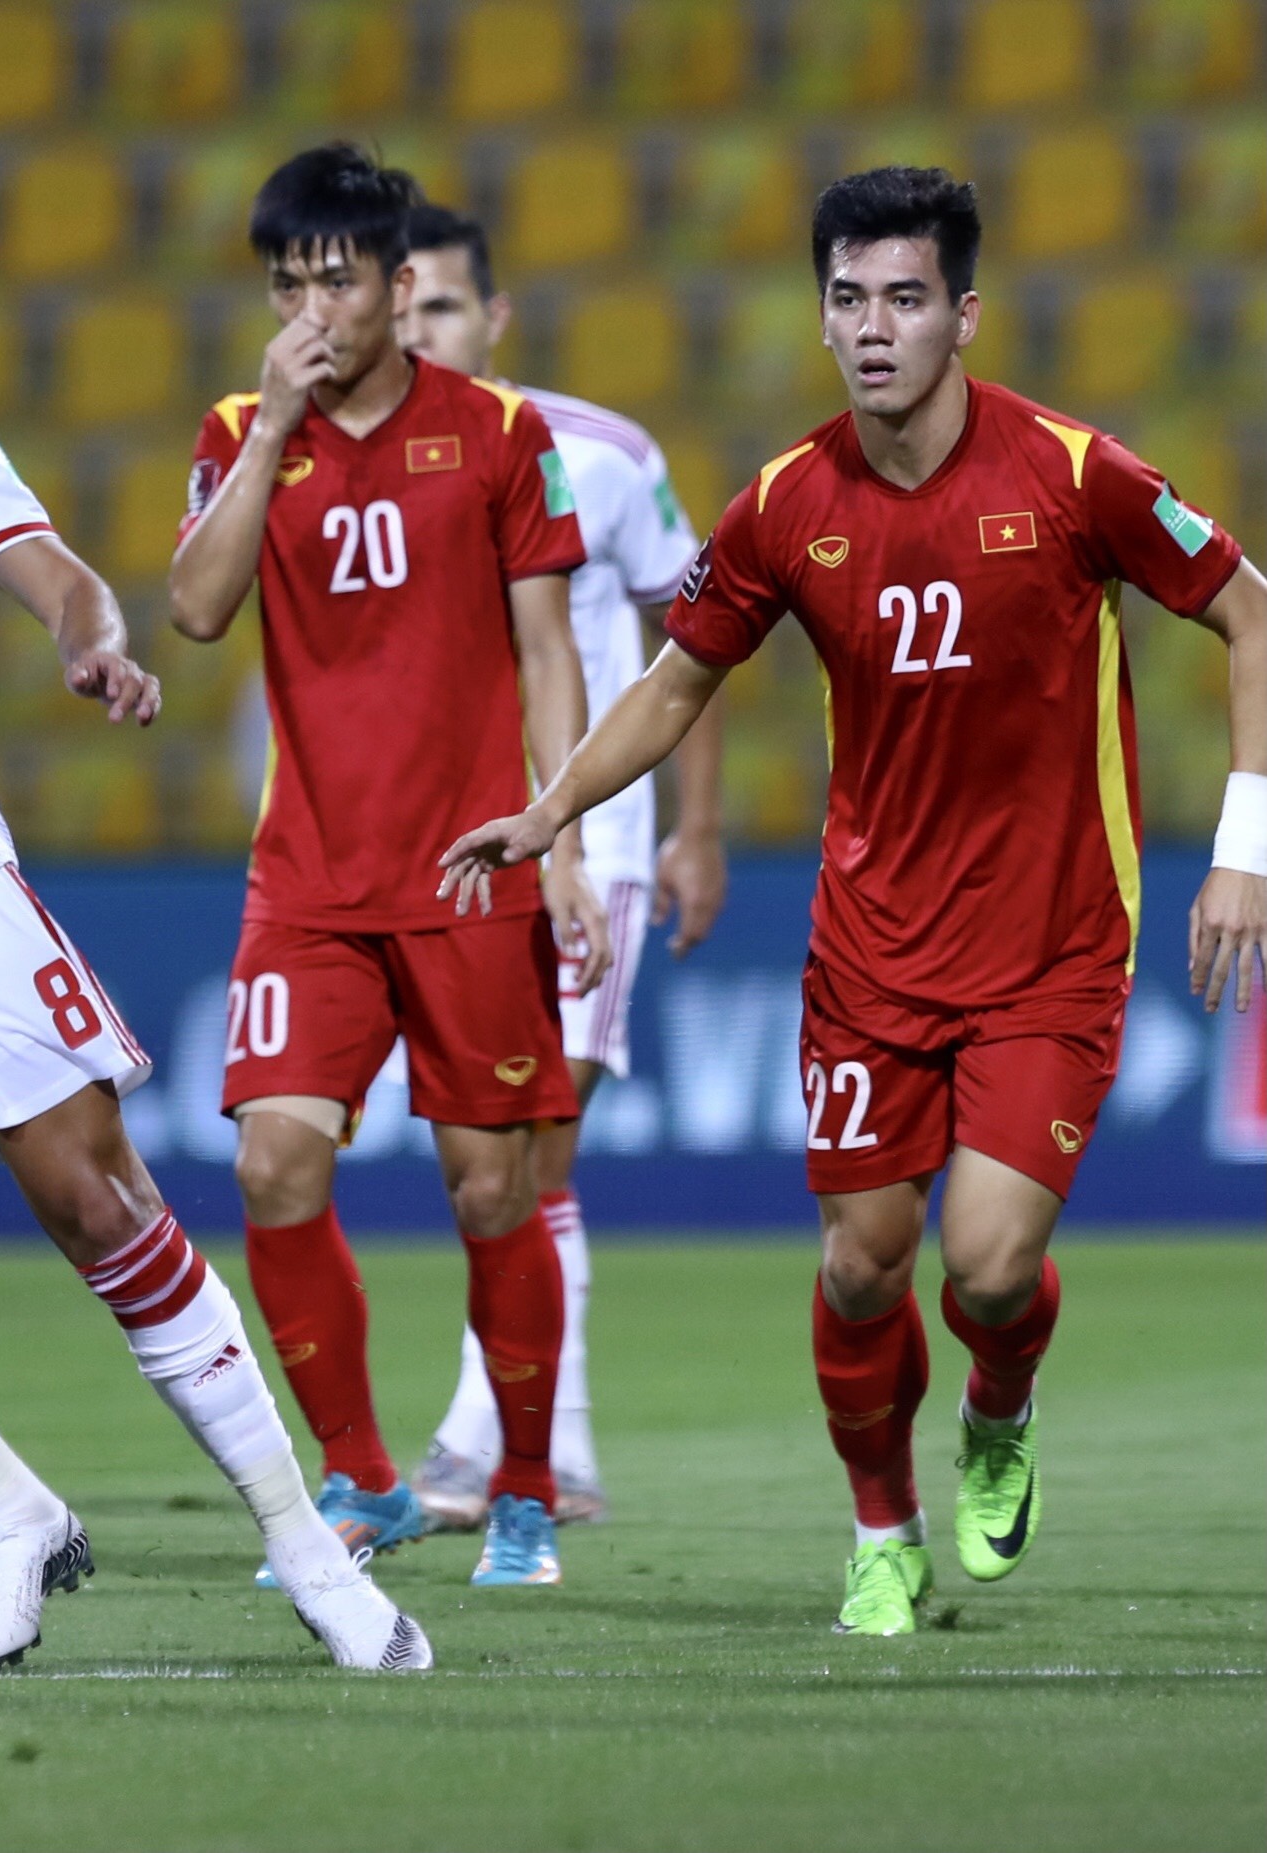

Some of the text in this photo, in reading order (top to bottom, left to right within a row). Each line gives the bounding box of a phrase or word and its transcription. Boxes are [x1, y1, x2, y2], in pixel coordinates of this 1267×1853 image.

[322, 499, 408, 594] 20
[878, 580, 972, 674] 22
[33, 957, 102, 1050] 8
[224, 971, 290, 1066] 20
[806, 1061, 878, 1150] 22
